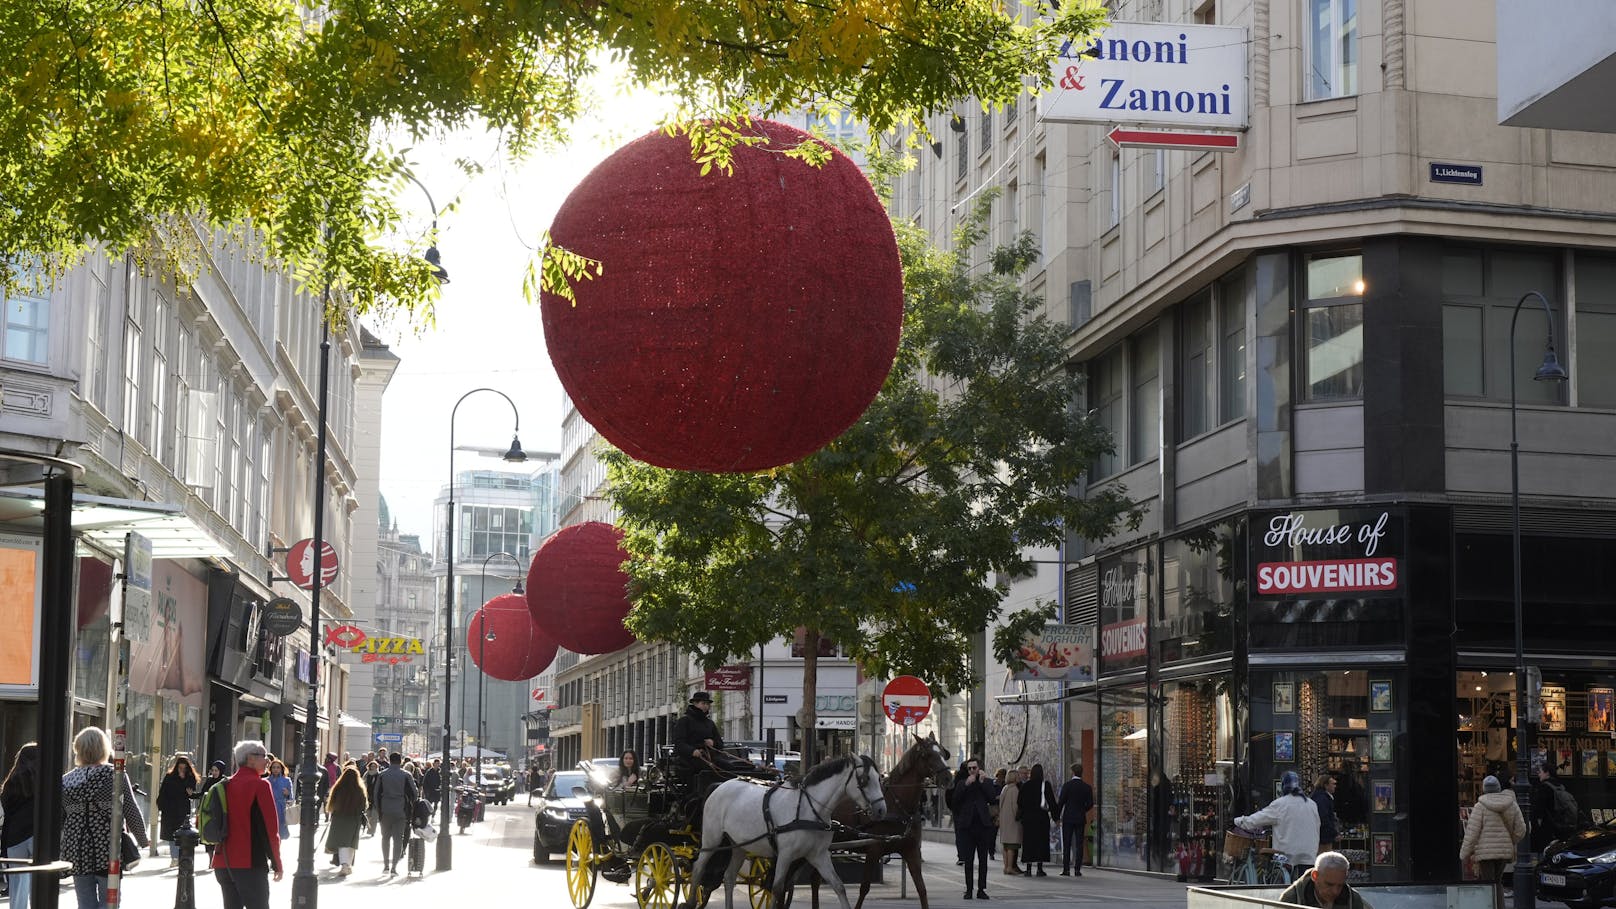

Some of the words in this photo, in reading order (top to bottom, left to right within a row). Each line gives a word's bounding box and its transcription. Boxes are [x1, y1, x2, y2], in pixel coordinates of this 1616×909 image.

[1060, 65, 1086, 91] &
[1099, 79, 1232, 115] Zanoni
[1263, 514, 1352, 548] House
[1357, 512, 1389, 557] of
[1102, 567, 1132, 608] House
[1259, 562, 1395, 590] SOUVENIRS
[352, 637, 425, 655] PIZZA
[1041, 635, 1092, 644] JOGHURT
[1044, 626, 1087, 635] FROZEN
[1101, 622, 1147, 657] SOUVENIRS
